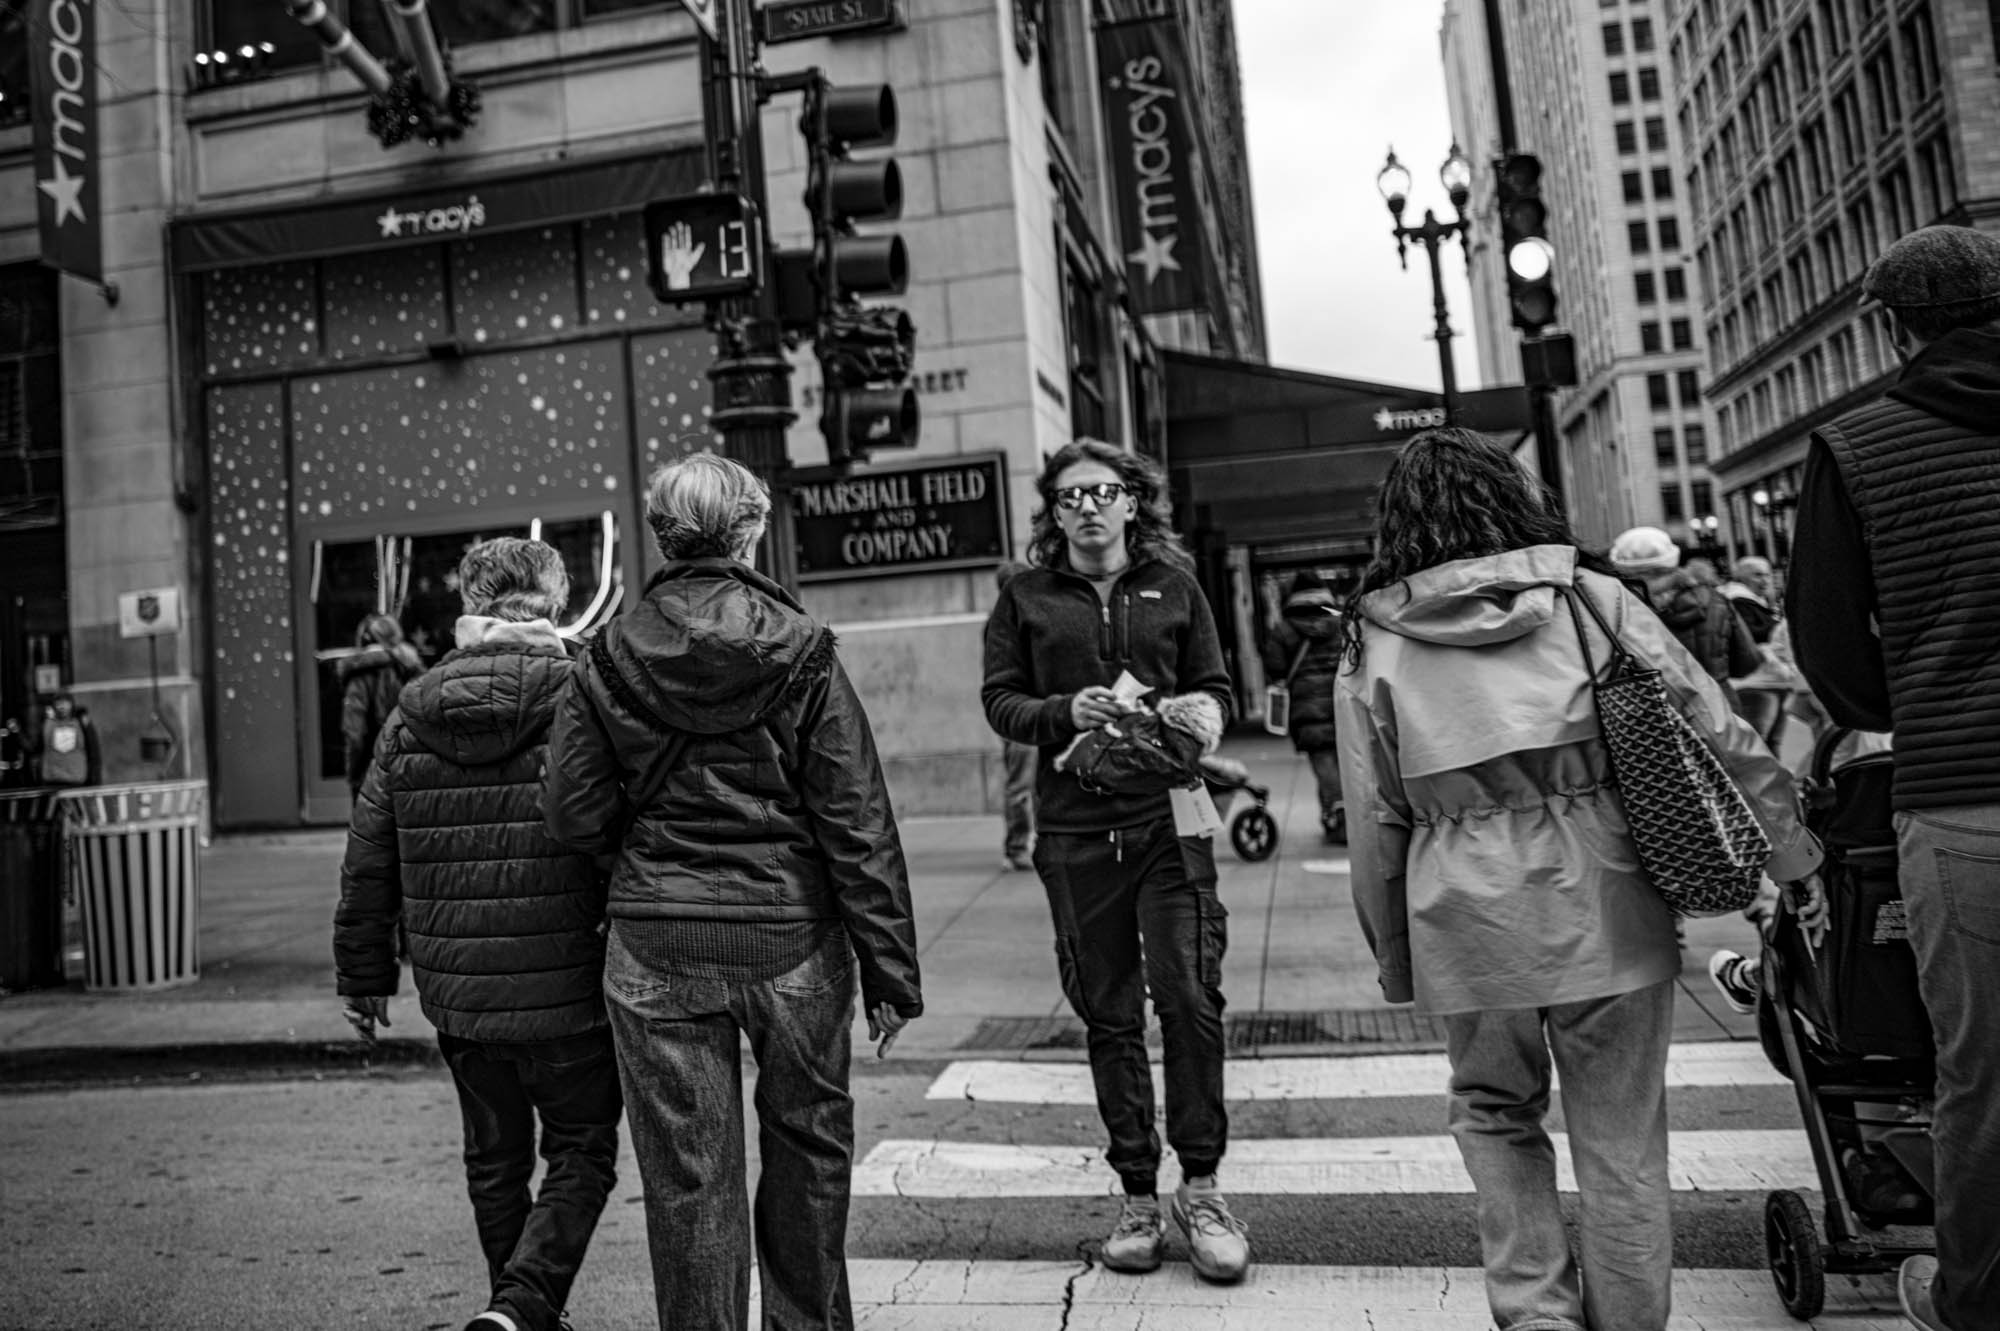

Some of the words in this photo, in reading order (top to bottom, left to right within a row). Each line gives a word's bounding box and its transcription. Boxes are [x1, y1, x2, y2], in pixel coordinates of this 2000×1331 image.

[1109, 55, 1179, 228] macy's
[403, 194, 485, 235] macy's
[719, 221, 751, 278] 13
[801, 475, 916, 516] MARSHALL
[922, 469, 986, 505] FIELD
[874, 508, 917, 528] AND
[841, 524, 953, 565] COMPANY
